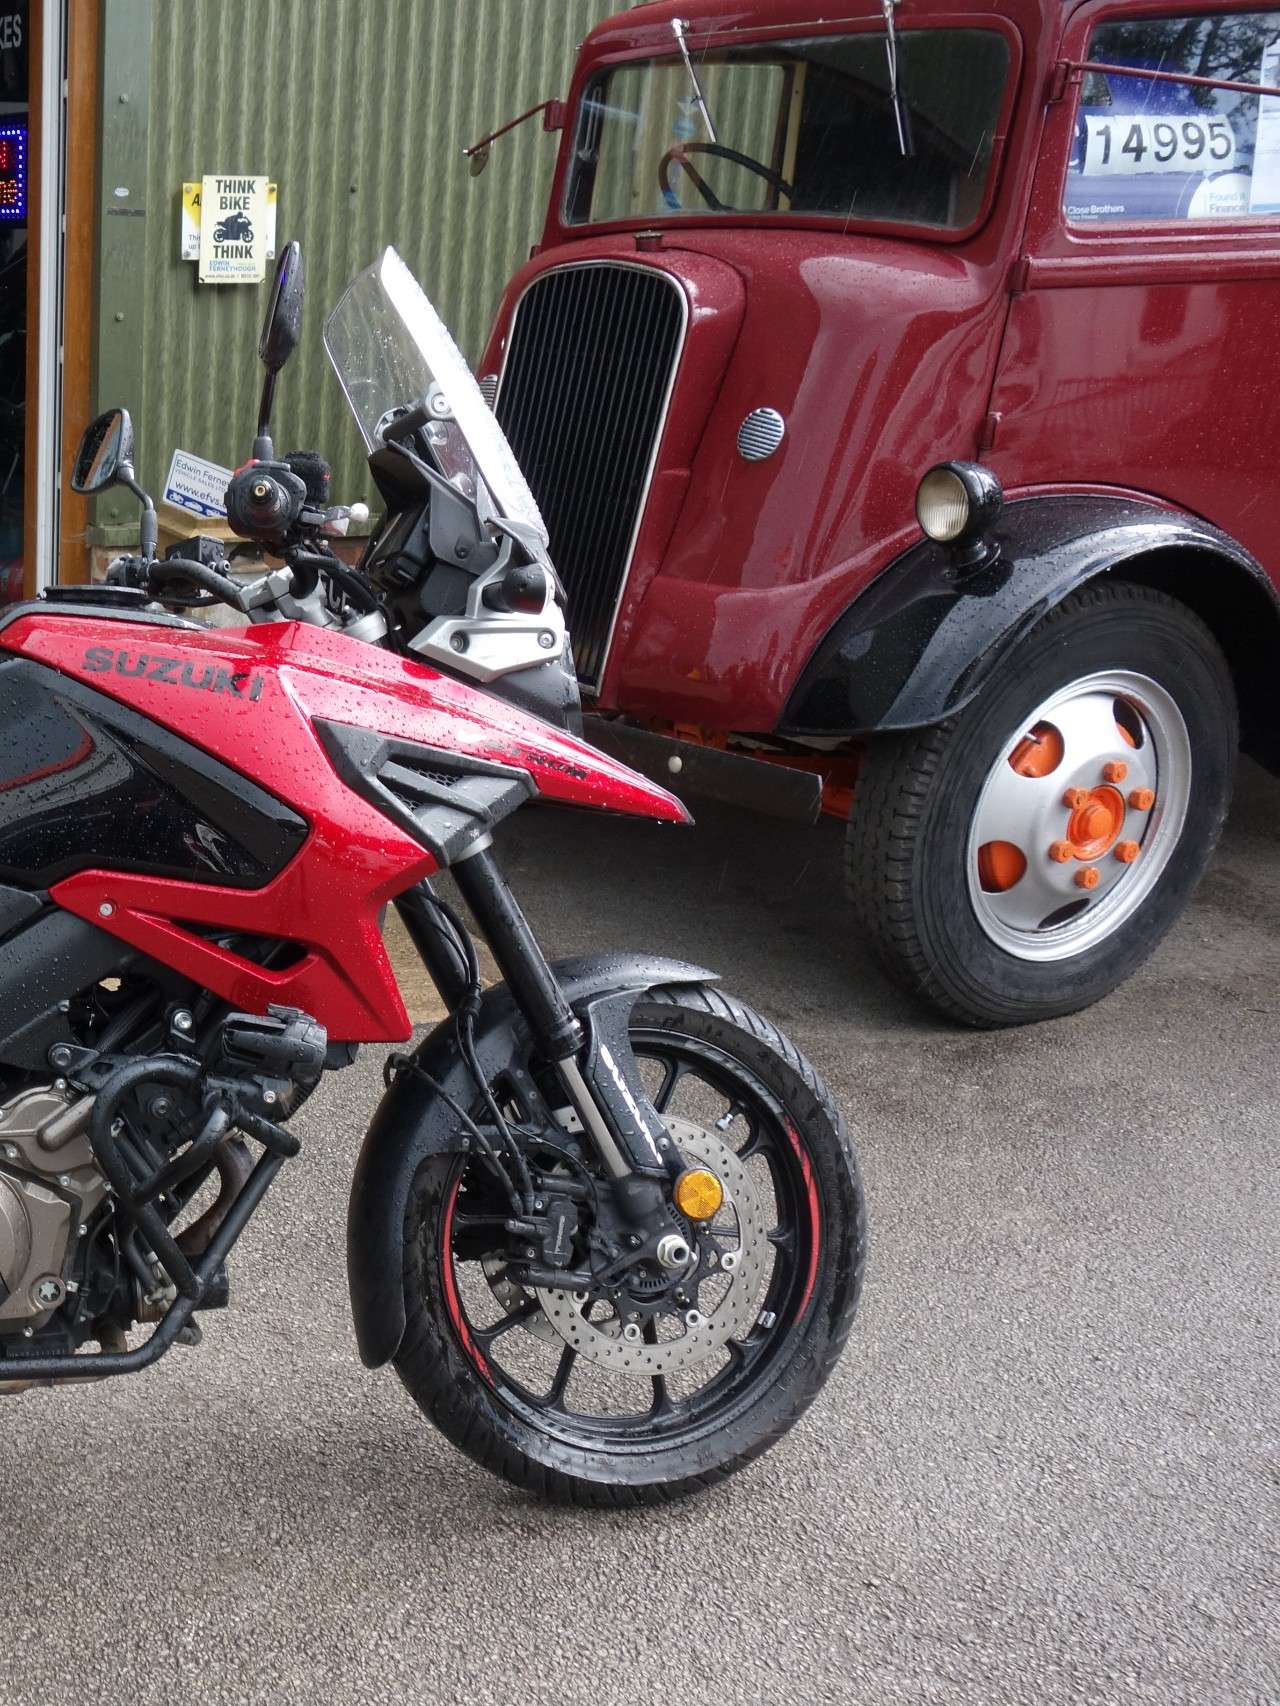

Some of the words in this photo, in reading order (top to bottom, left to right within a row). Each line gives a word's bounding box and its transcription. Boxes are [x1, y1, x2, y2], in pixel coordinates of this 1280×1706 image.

[1096, 122, 1232, 165] 14995
[216, 179, 256, 194] THINK
[220, 196, 250, 210] BIKE
[213, 245, 253, 259] THINK
[176, 460, 201, 476] Edwin
[81, 646, 264, 702] SUZUKI
